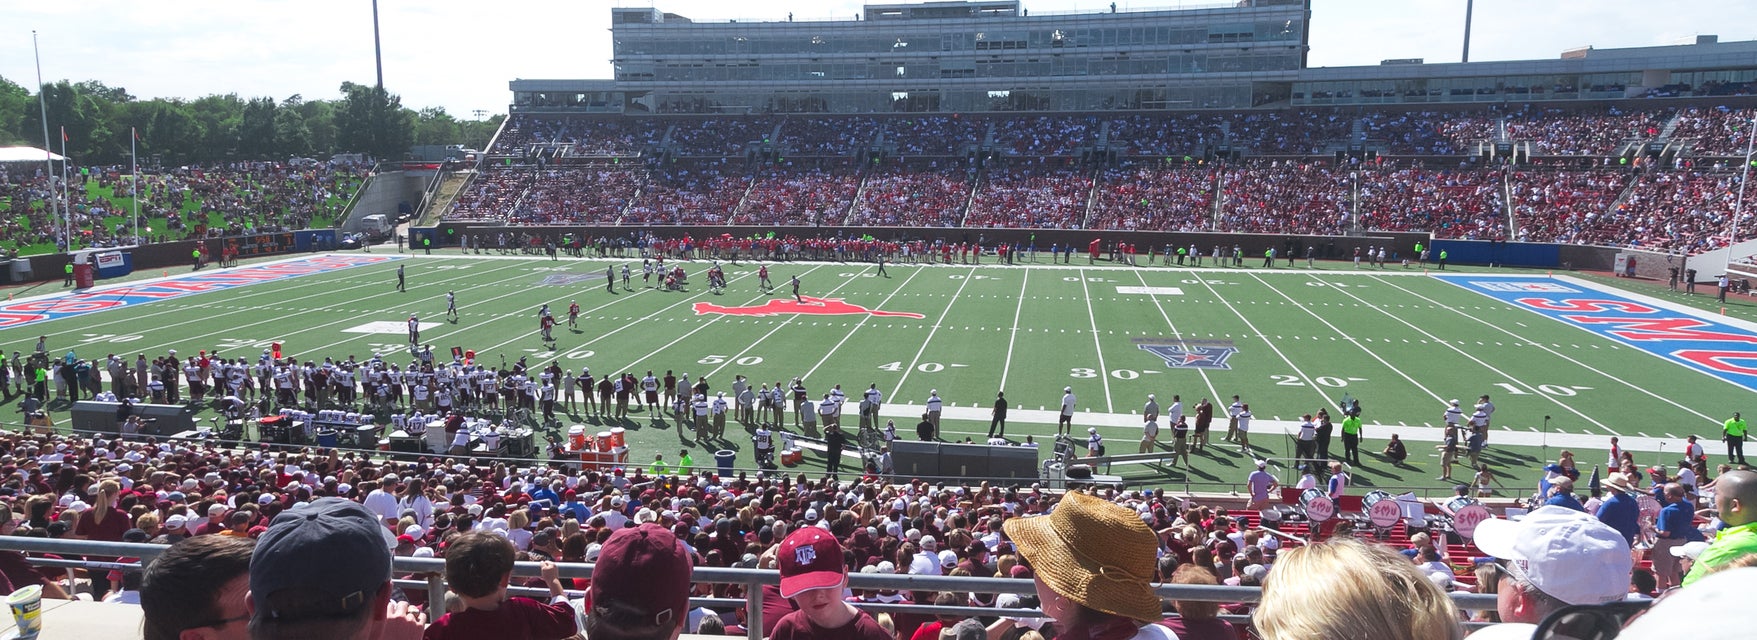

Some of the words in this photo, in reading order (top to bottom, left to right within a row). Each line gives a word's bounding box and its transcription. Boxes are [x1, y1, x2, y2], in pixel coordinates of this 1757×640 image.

[99, 254, 121, 264] ESPN
[697, 354, 763, 366] 50
[877, 361, 944, 373] 40
[1069, 367, 1139, 380] 30
[1270, 374, 1348, 388] 20
[1493, 383, 1578, 397] 10
[1374, 504, 1397, 517] SMU
